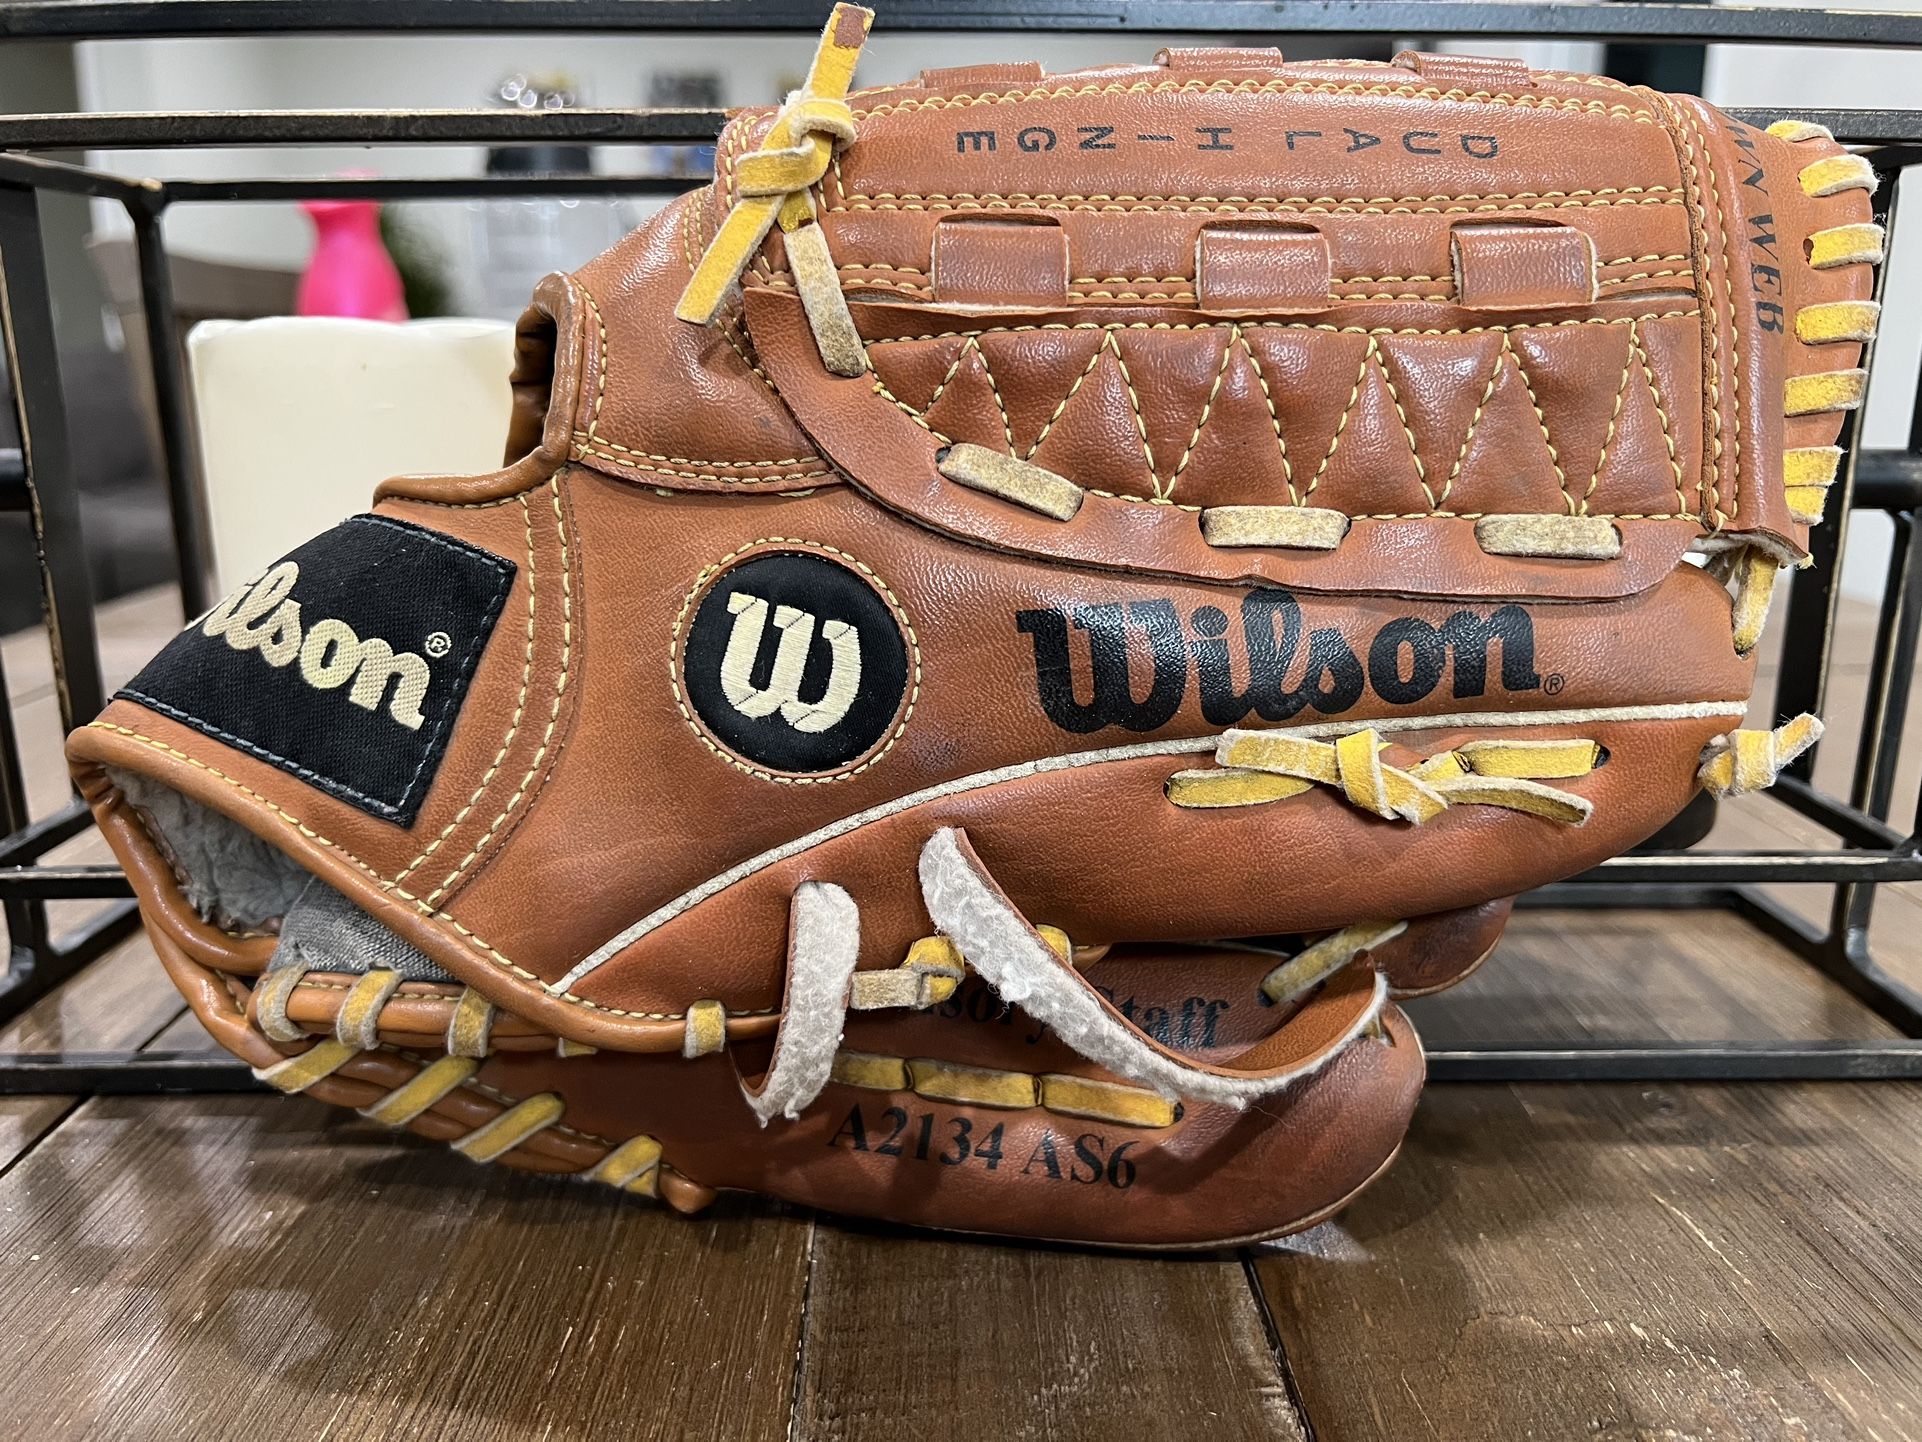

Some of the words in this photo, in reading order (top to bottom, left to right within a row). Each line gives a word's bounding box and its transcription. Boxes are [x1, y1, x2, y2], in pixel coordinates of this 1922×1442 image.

[956, 125, 1234, 153] HINGE
[1285, 127, 1498, 159] DUAL
[1718, 112, 1769, 197] WN
[1748, 213, 1785, 336] WEB
[184, 560, 431, 732] ilson
[720, 591, 862, 734] W
[1016, 588, 1541, 734] Wilson
[827, 1102, 1005, 1171] A2134
[1020, 1127, 1141, 1190] AS6
